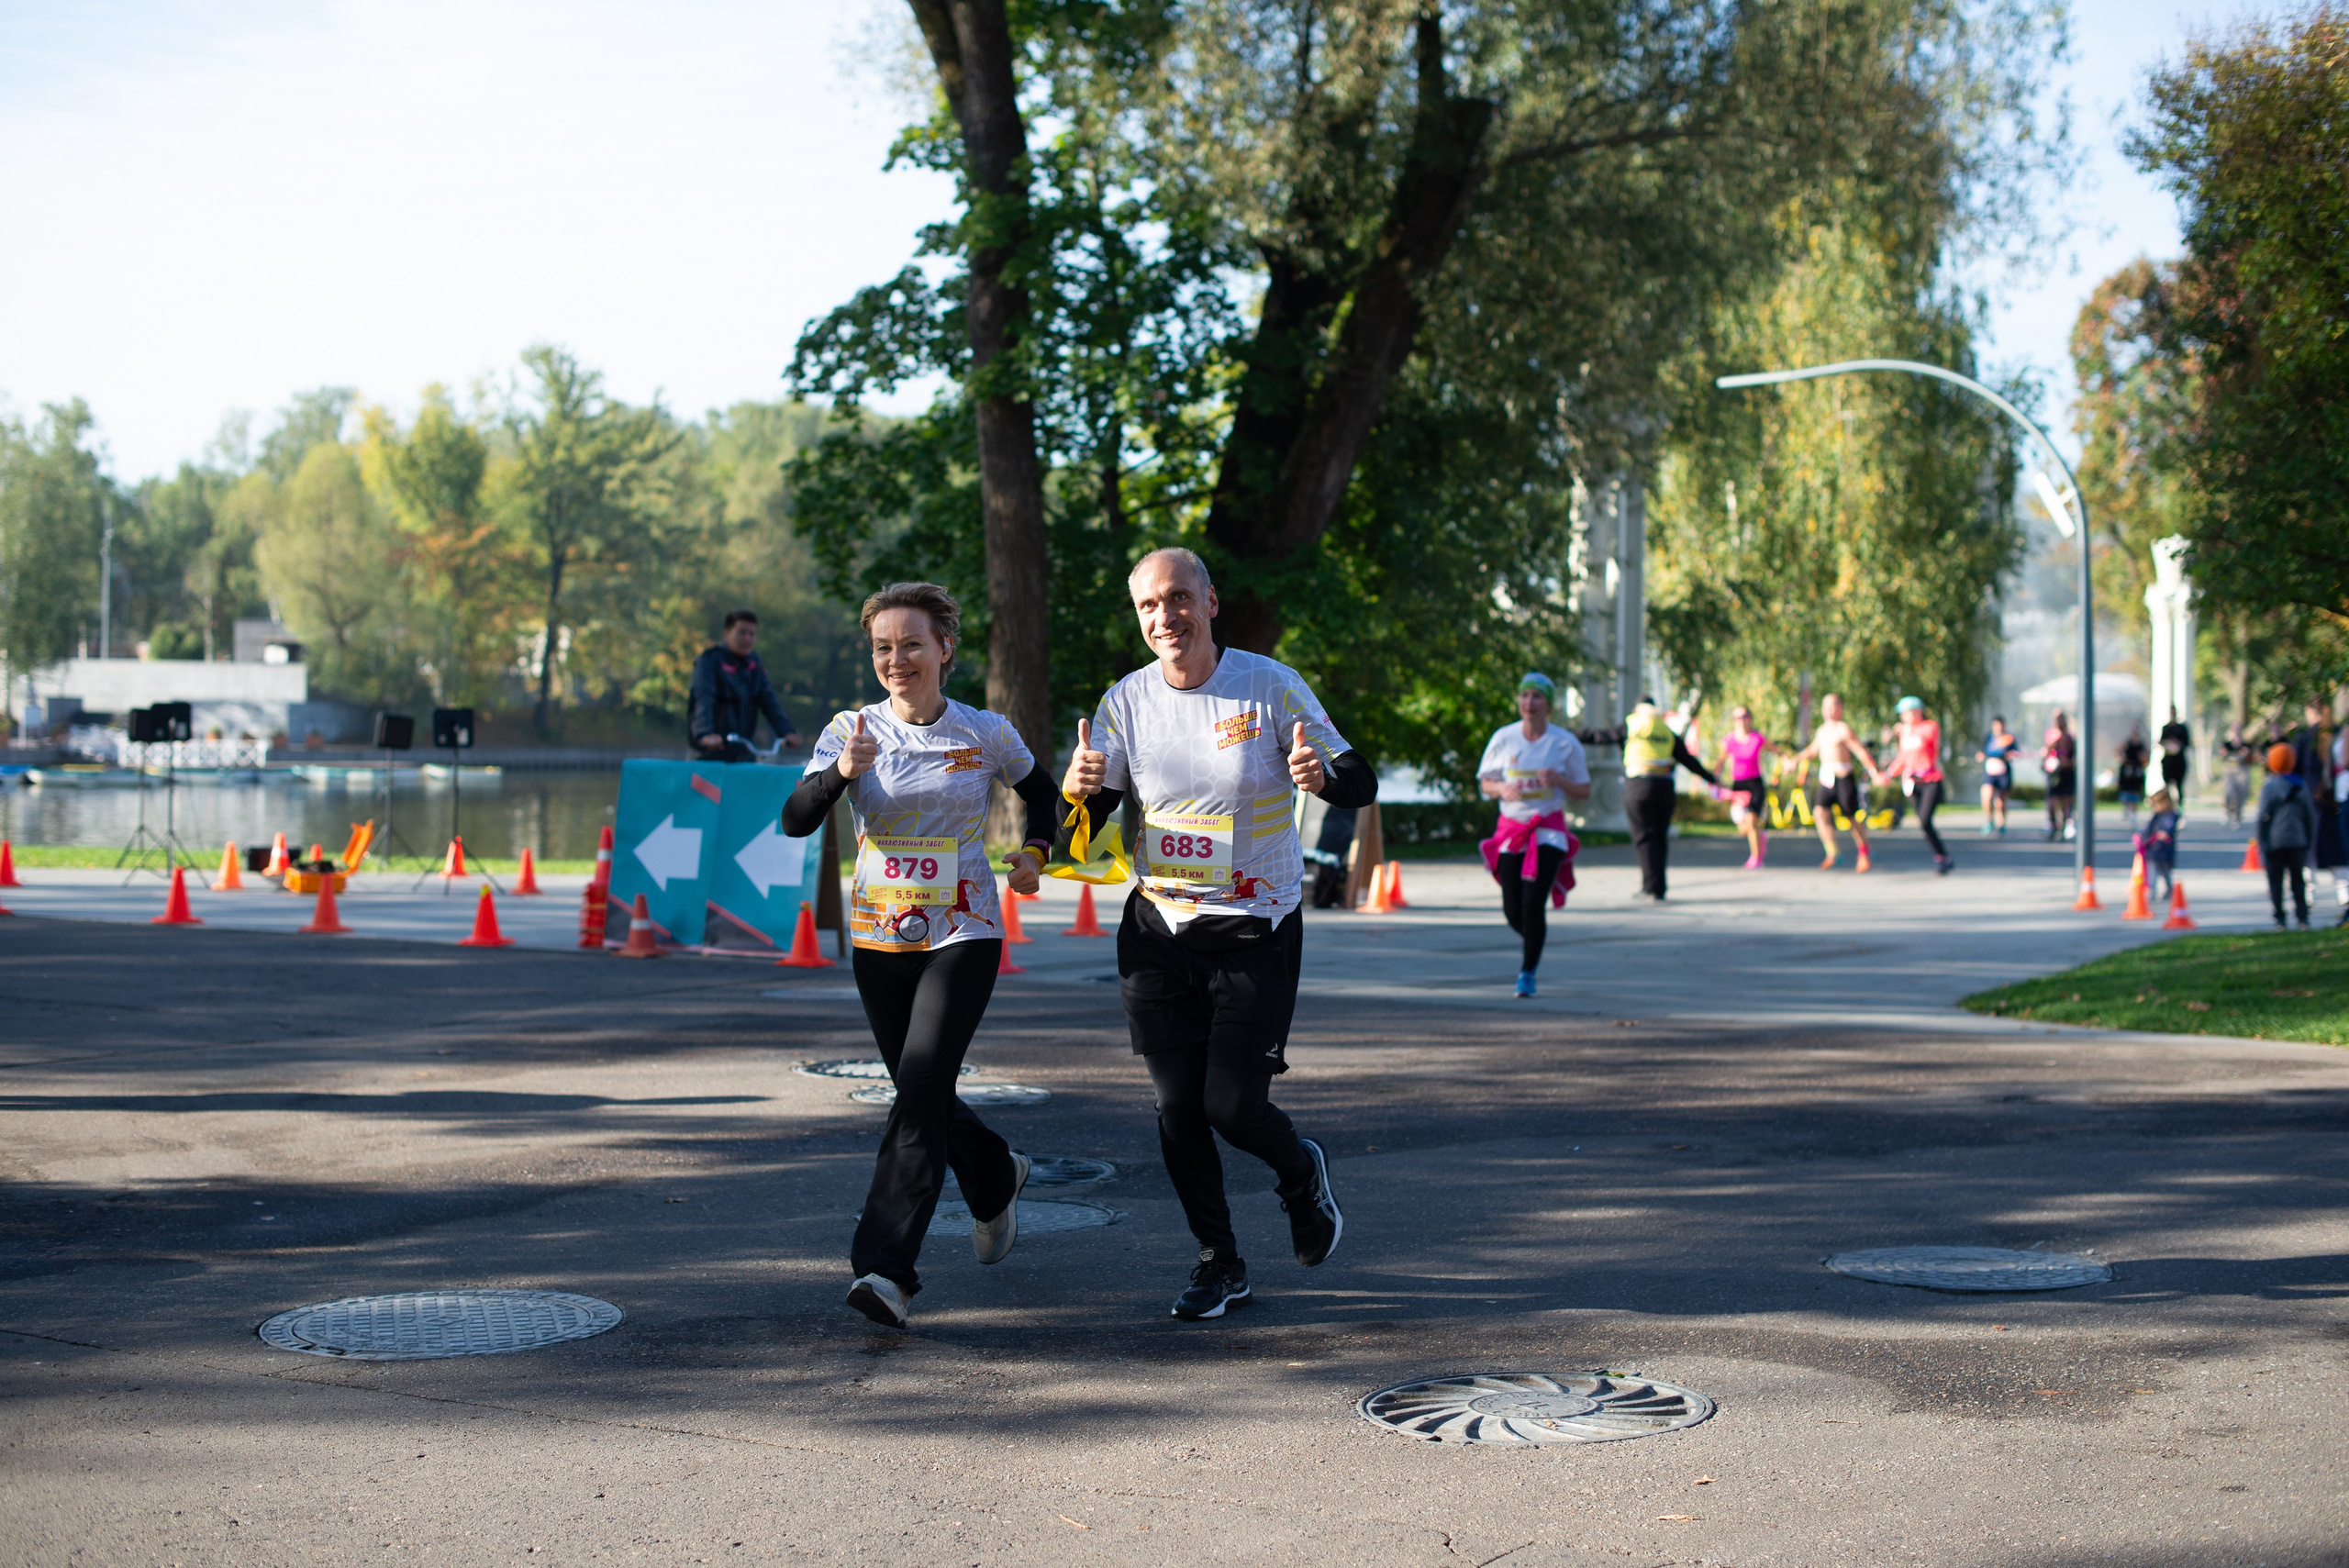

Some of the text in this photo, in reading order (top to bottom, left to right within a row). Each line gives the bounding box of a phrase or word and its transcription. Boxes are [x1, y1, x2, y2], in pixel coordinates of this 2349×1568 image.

[1219, 711, 1257, 729] БОЛЬШЕ
[1227, 723, 1248, 735] ЧЕМ
[1219, 729, 1260, 749] МОЖЕШЬ
[947, 748, 981, 758] БОЛЬШЕ
[946, 762, 981, 773] МОЖЕШЬ
[1154, 817, 1198, 825] ИНКЛЮЗИВНЫЙ
[877, 839, 924, 847] ИНКЛЮЗИВНЫЙ
[1161, 834, 1213, 859] 683
[884, 856, 939, 880] 879
[1172, 868, 1186, 879] 5,5
[896, 890, 913, 901] 5,5
